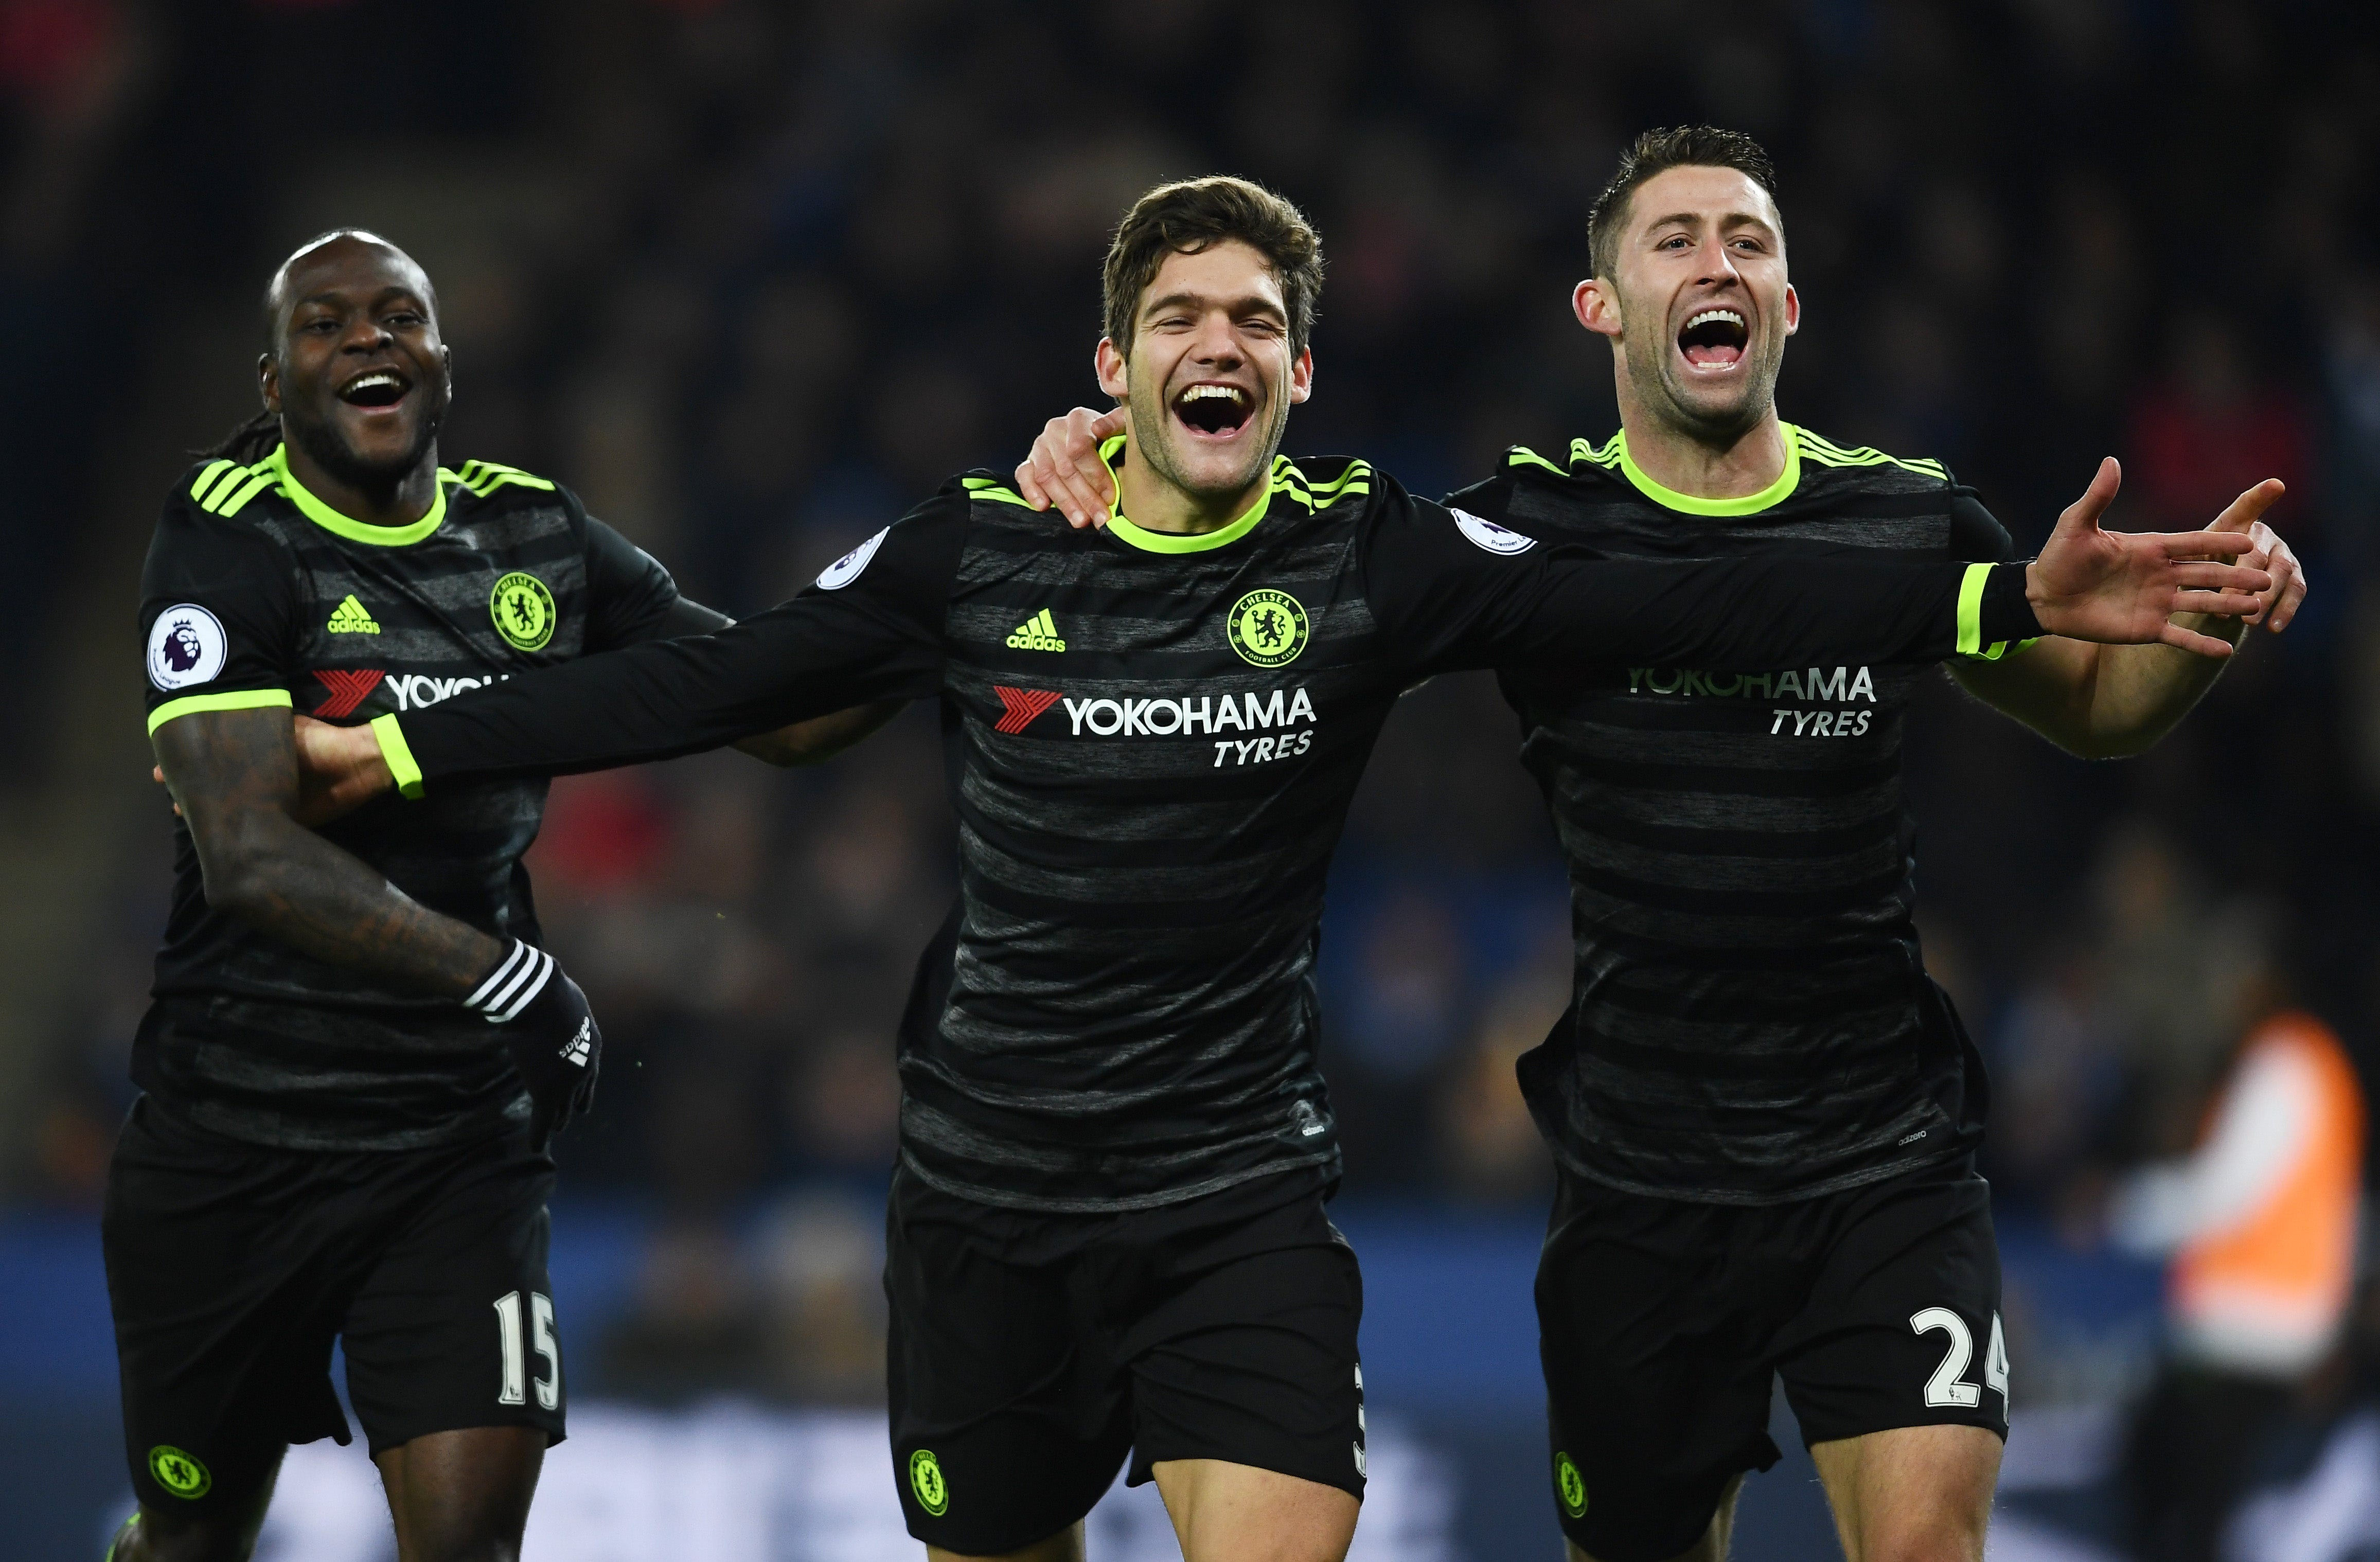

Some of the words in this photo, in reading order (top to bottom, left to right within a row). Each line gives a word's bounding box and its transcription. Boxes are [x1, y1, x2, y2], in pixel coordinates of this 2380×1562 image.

[1239, 593, 1290, 611] CHELSEA
[327, 617, 381, 635] adidas
[1006, 633, 1066, 652] adidas
[1062, 687, 1317, 736] YOKOHAMA
[1770, 709, 1873, 737] TYRES
[1213, 729, 1313, 767] TYRES
[493, 1290, 559, 1410] 15
